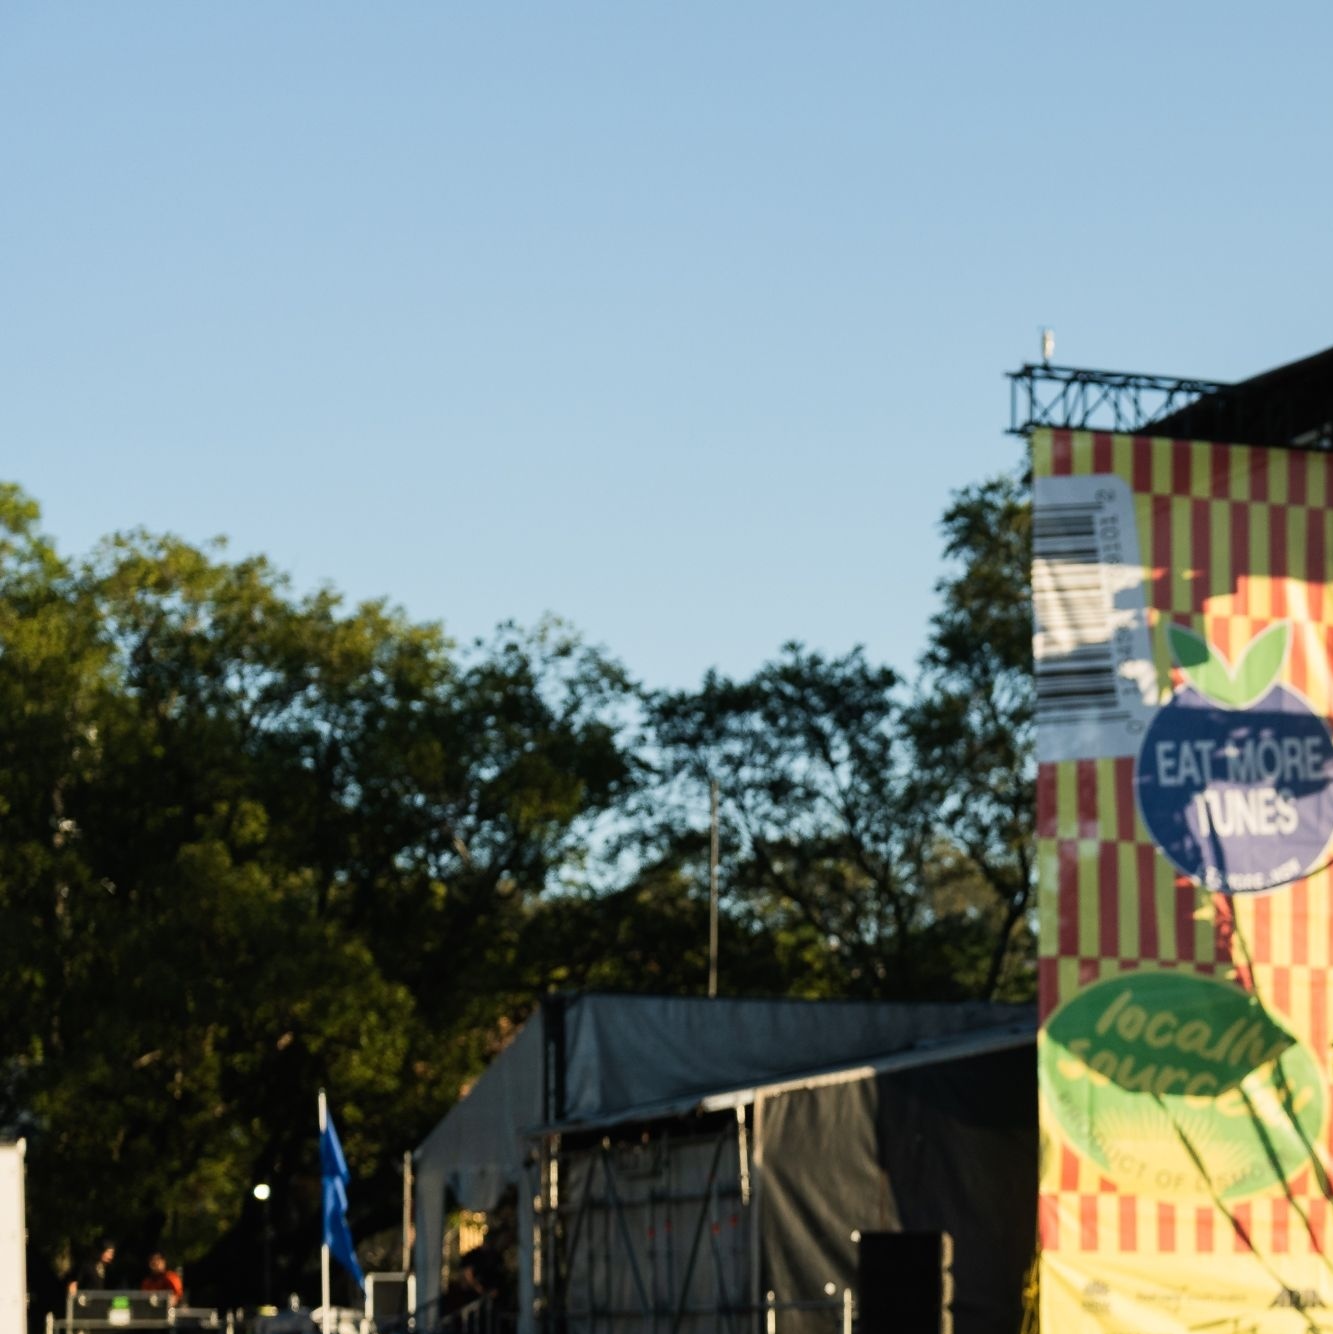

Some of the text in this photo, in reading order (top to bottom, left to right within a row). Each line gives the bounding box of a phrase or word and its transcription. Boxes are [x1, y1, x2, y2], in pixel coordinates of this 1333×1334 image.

[1156, 734, 1326, 787] EAT MORE
[1193, 786, 1299, 838] TUNES
[1156, 1167, 1188, 1187] OF
